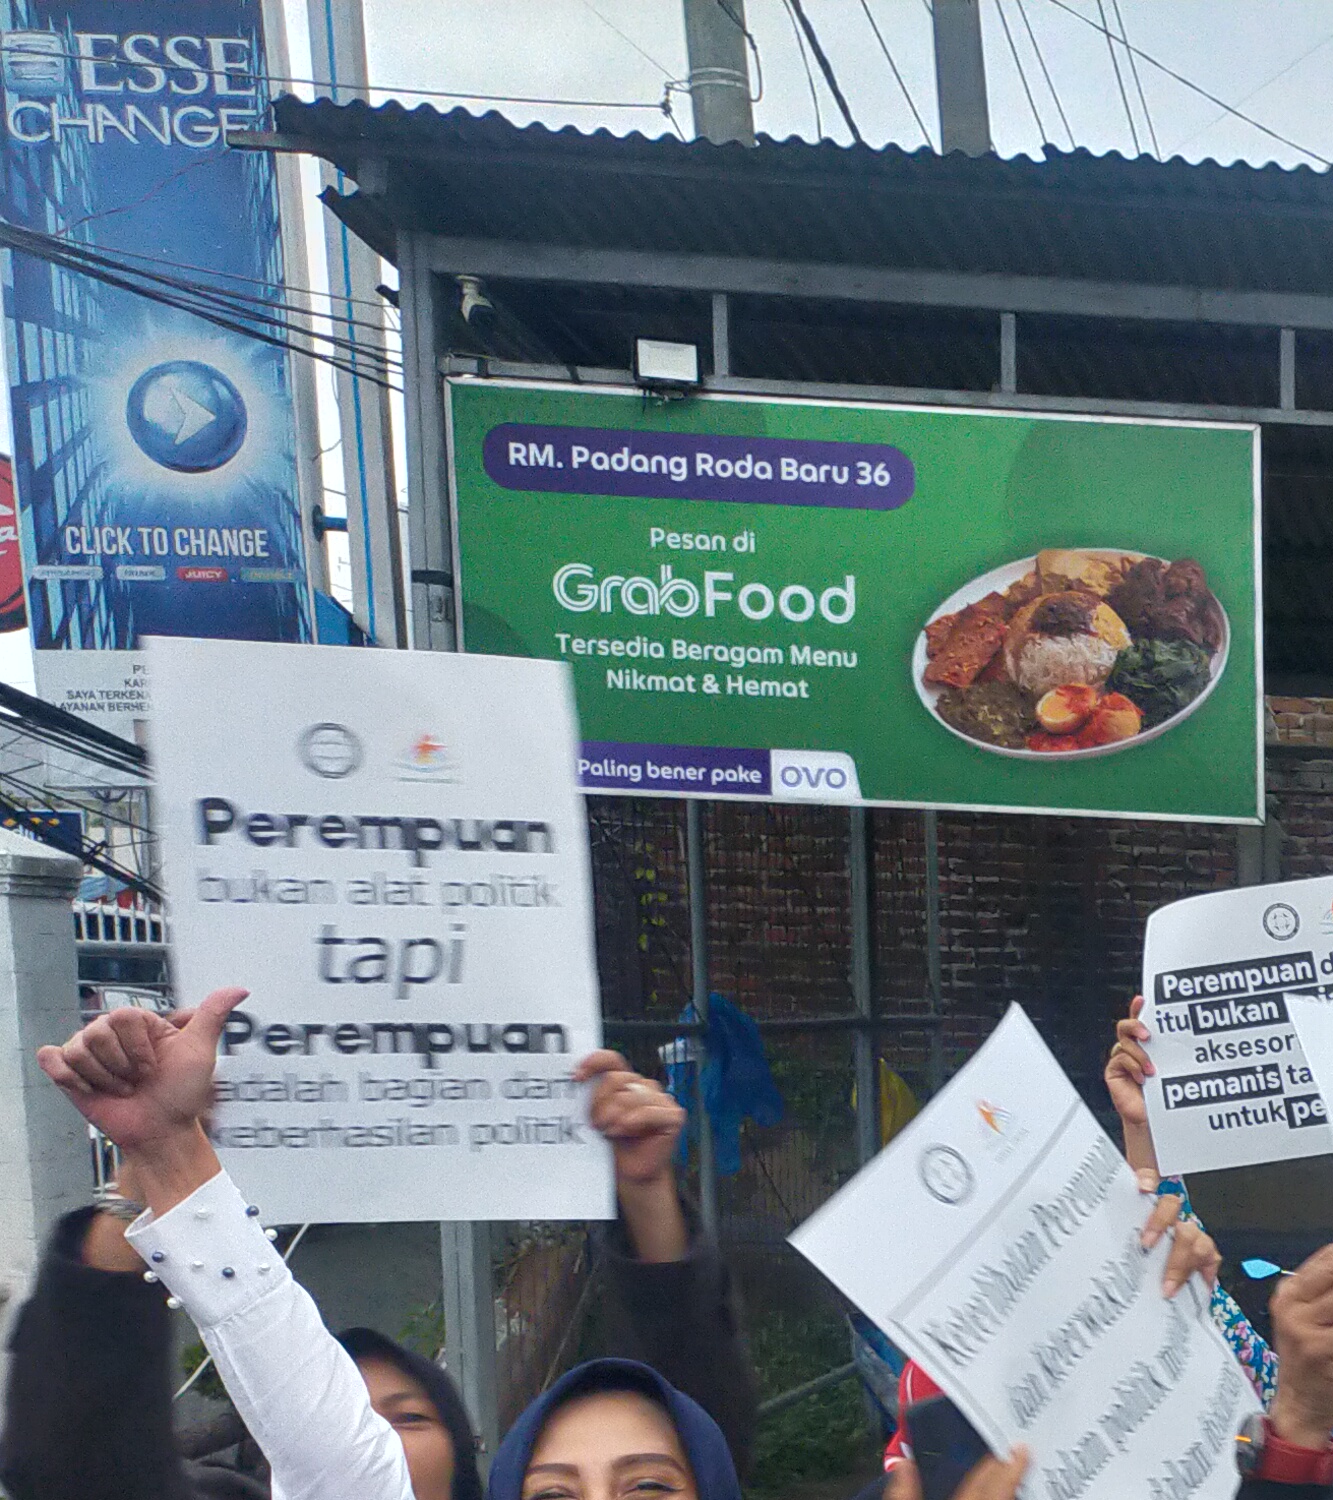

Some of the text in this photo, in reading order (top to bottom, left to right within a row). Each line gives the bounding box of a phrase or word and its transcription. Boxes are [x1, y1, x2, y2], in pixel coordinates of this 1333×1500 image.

[75, 33, 256, 96] ESSE
[7, 100, 257, 148] CHANGE
[508, 442, 890, 488] RM. Padang Roda Baru 36
[65, 525, 270, 557] CLICK TO CHANGE
[649, 527, 756, 554] Pesan di
[184, 570, 222, 580] JUICY
[553, 563, 855, 624] GrabFood
[555, 633, 858, 671] Tersedia Beragam Menu
[66, 690, 96, 700] SAYA
[606, 668, 809, 700] Nikmat & Hemat
[577, 758, 848, 791] Paling bener pake OVO
[197, 797, 556, 868] Perempuan
[198, 868, 562, 912] bukan alat politik
[316, 923, 466, 1000] tapi
[1162, 960, 1314, 1000] Perempuan
[1155, 1010, 1191, 1034] itu
[1196, 999, 1280, 1029] bukan
[220, 1010, 571, 1069] Perempuan
[1194, 1032, 1300, 1064] aksesor
[213, 1072, 350, 1102] adalah
[359, 1071, 489, 1107] bagian
[1165, 1065, 1282, 1110] pemanis
[212, 1114, 586, 1151] keberhasilan politik
[1208, 1099, 1286, 1131] untuk
